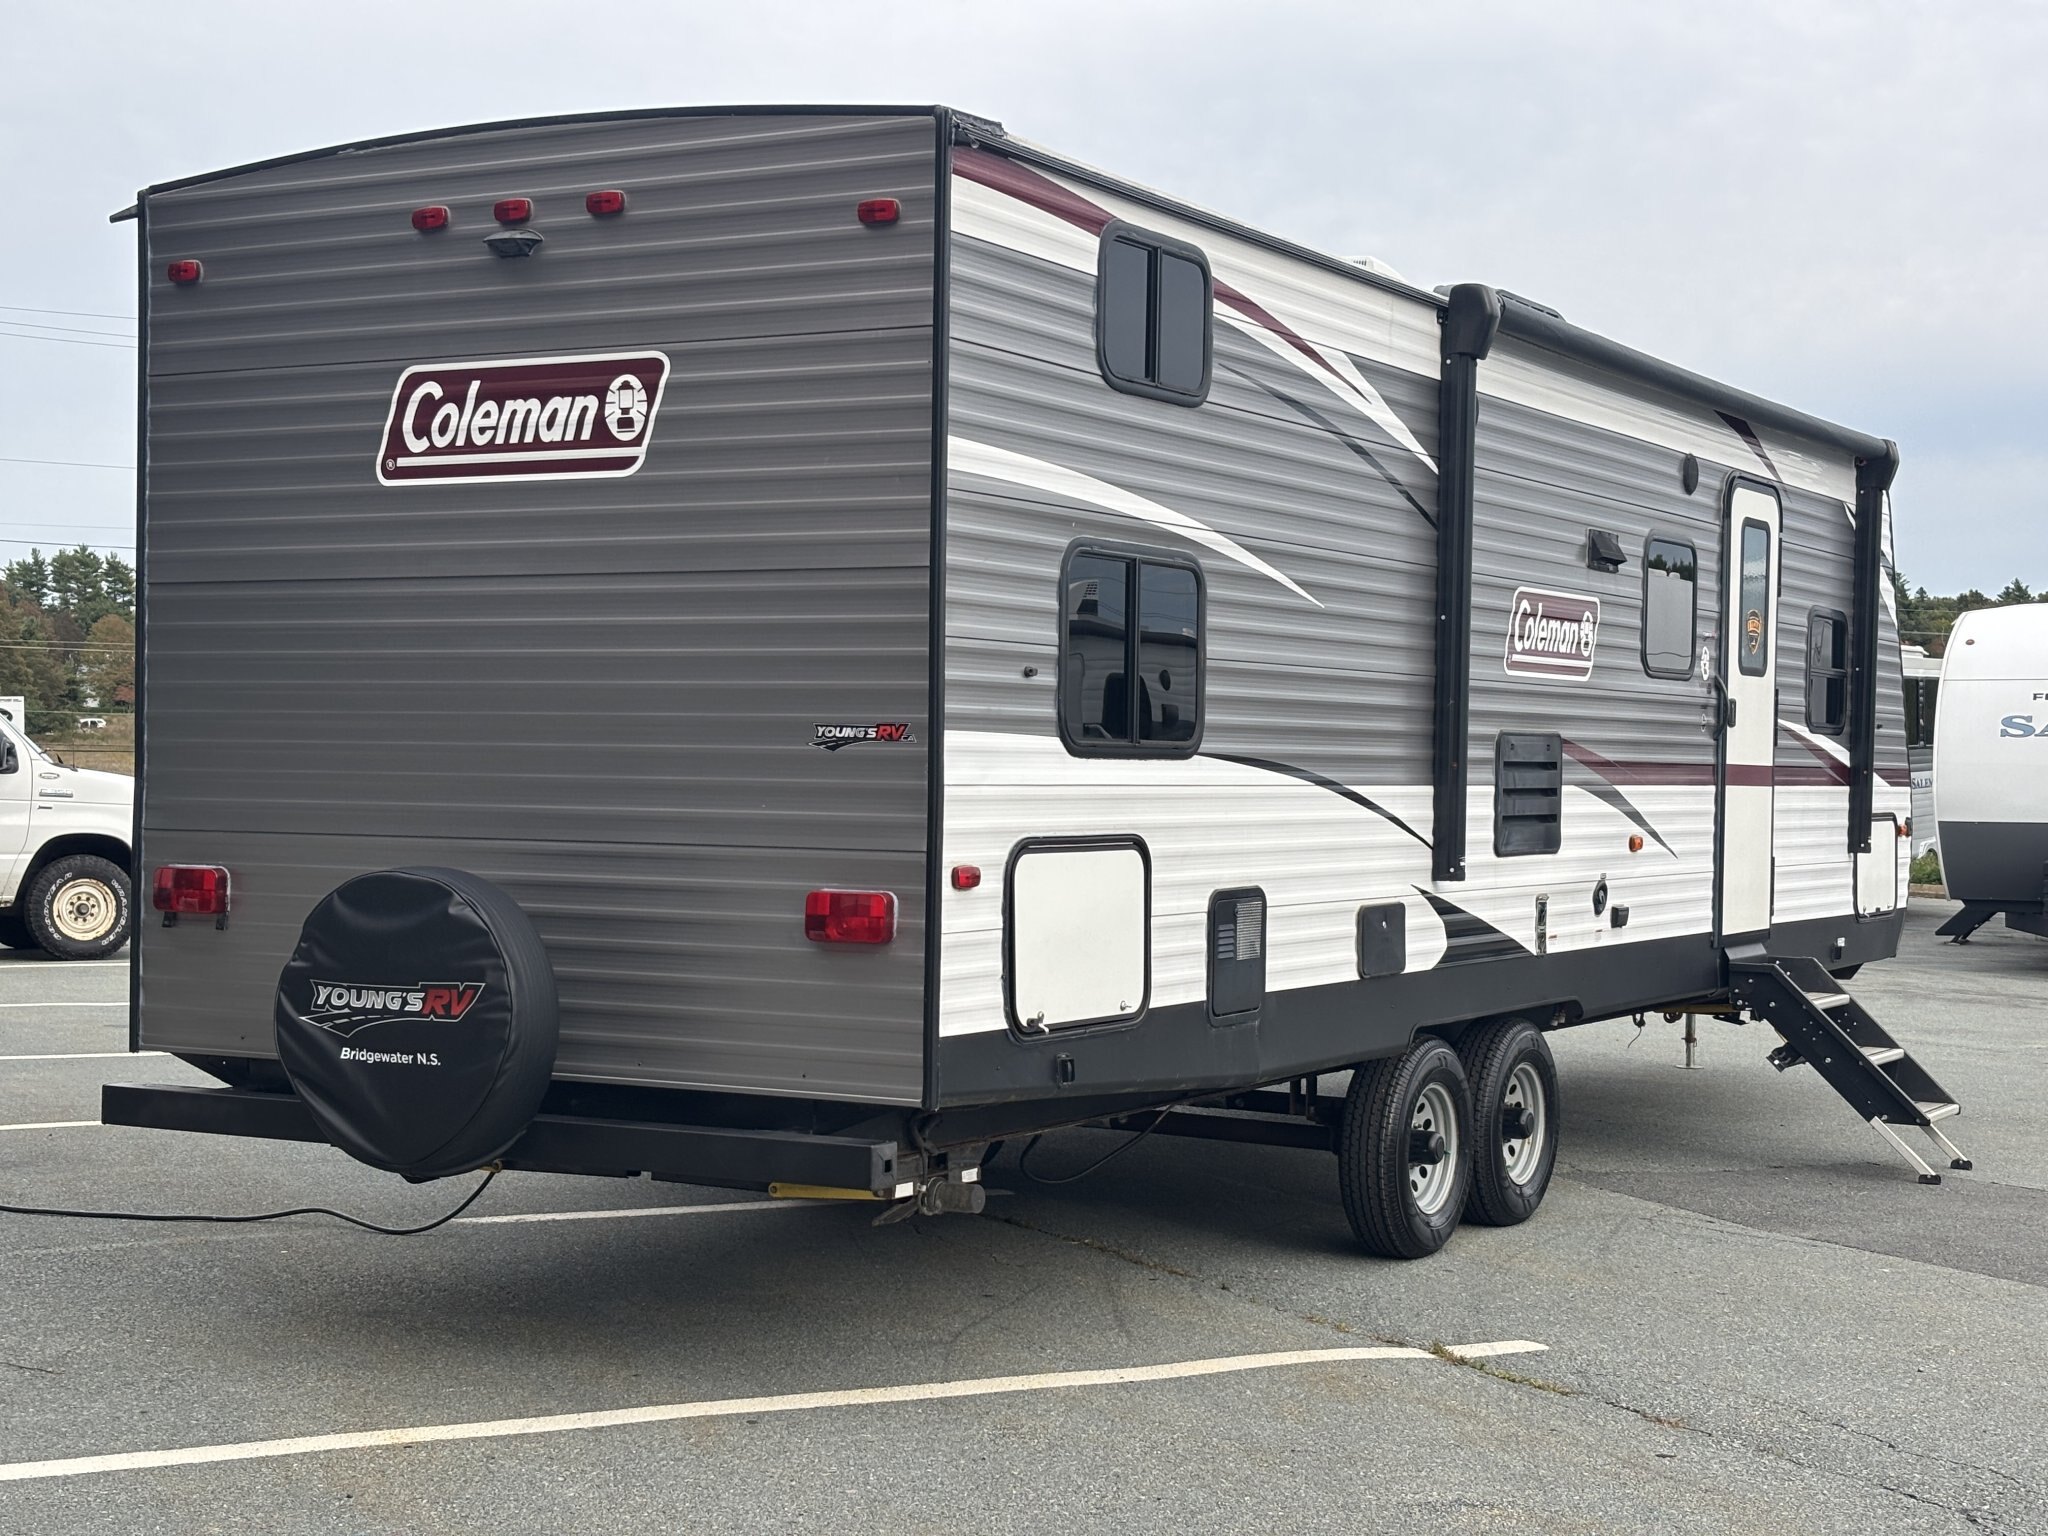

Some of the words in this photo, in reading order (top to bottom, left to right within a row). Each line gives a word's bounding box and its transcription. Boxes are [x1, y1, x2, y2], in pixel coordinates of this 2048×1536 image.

[402, 380, 599, 453] Coleman
[1514, 599, 1579, 654] Coleman
[340, 1047, 414, 1064] Bridgewater
[417, 1053, 441, 1066] N.S.
